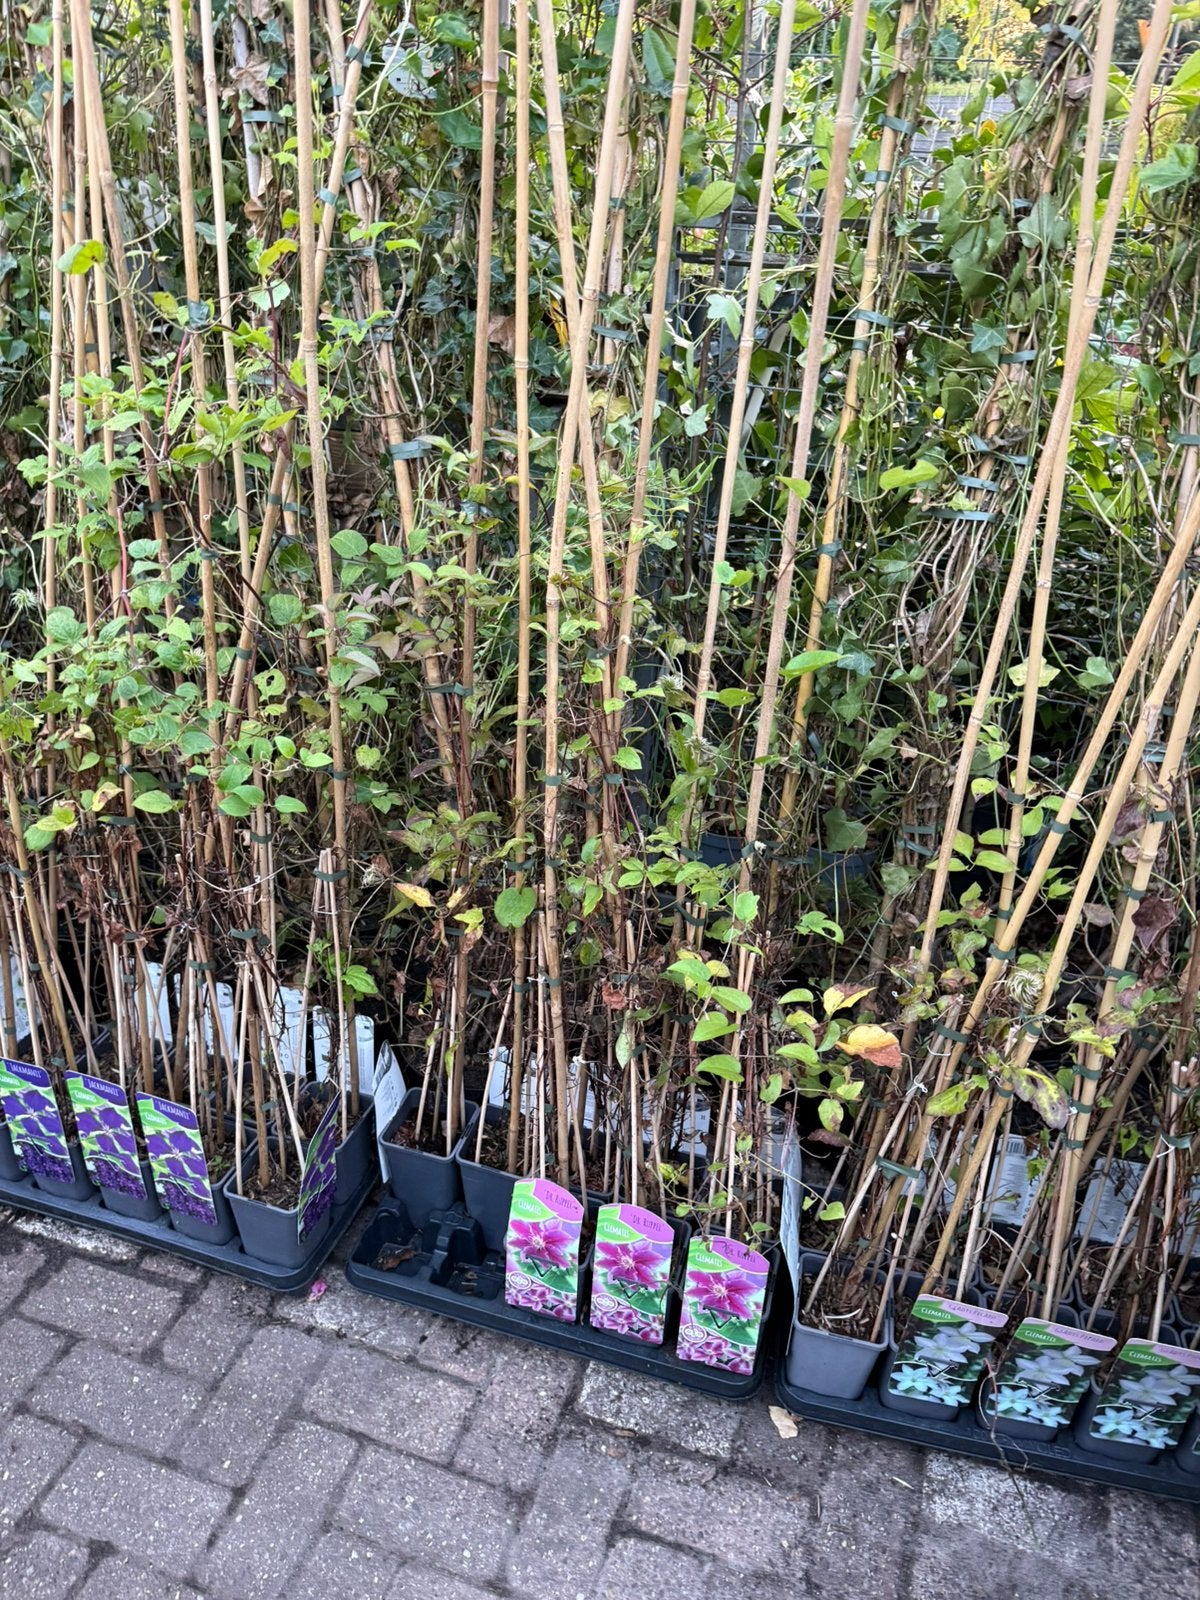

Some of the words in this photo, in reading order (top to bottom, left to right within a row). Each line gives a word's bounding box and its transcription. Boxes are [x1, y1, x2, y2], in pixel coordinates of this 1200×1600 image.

[518, 1198, 541, 1216] CLEMATIS
[603, 1222, 629, 1238] CLEMATIS
[695, 1252, 722, 1267] CLEMATIS
[921, 1307, 951, 1319] CLEMATIS
[1025, 1329, 1056, 1342] CLEMATIS
[1129, 1351, 1162, 1363] CLEMATIS
